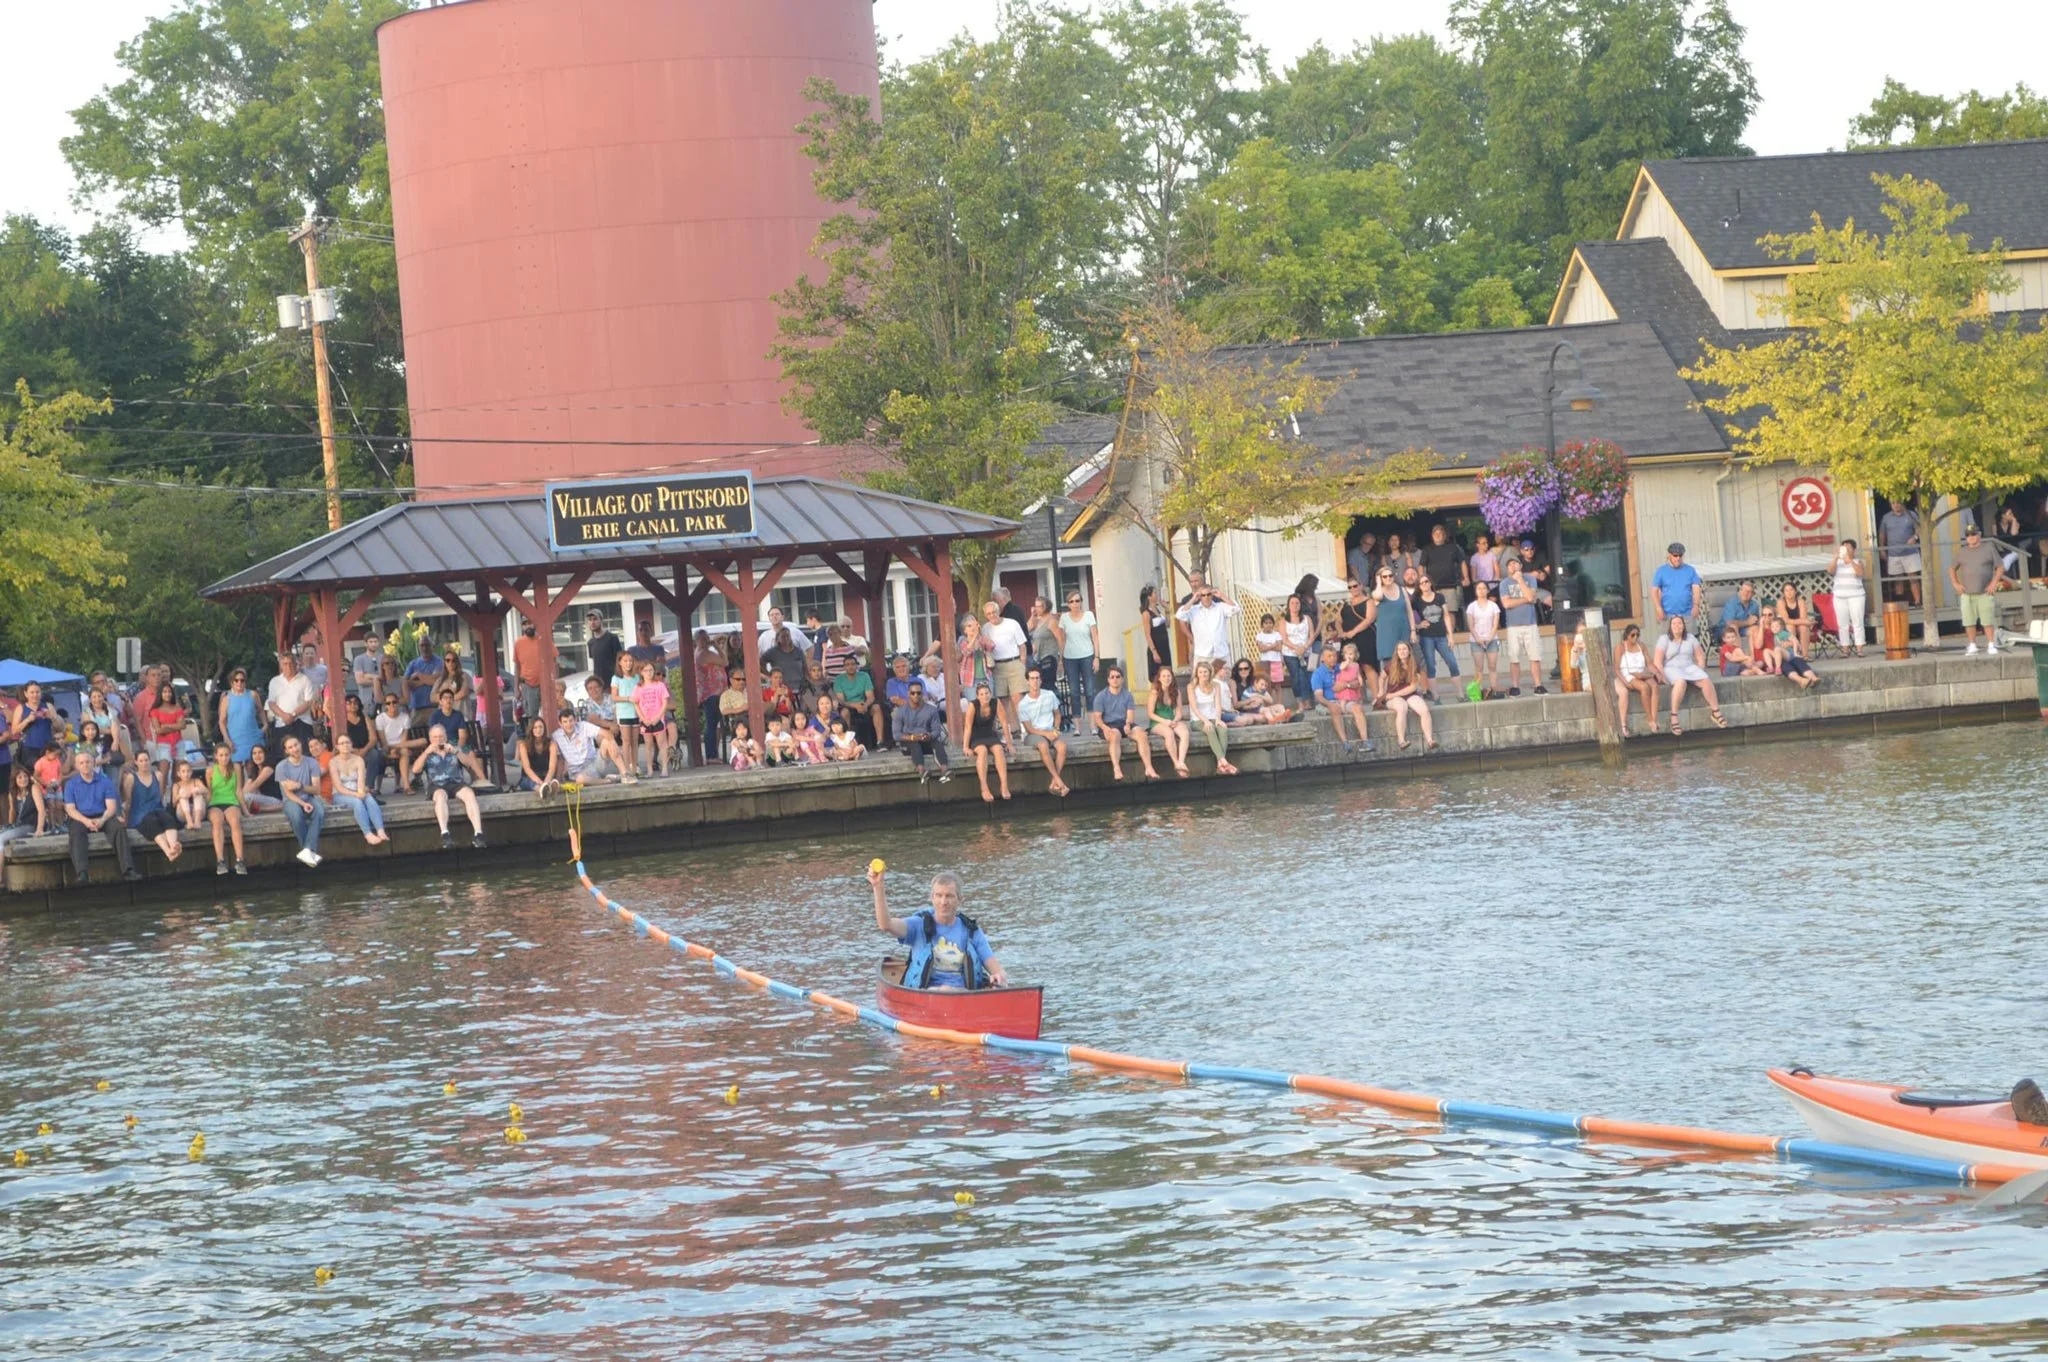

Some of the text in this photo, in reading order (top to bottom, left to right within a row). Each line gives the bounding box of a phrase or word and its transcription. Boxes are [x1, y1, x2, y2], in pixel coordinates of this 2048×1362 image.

[554, 486, 748, 520] VILLAGE OF PITTSFORD
[582, 514, 727, 540] ERIE CANAL PARK
